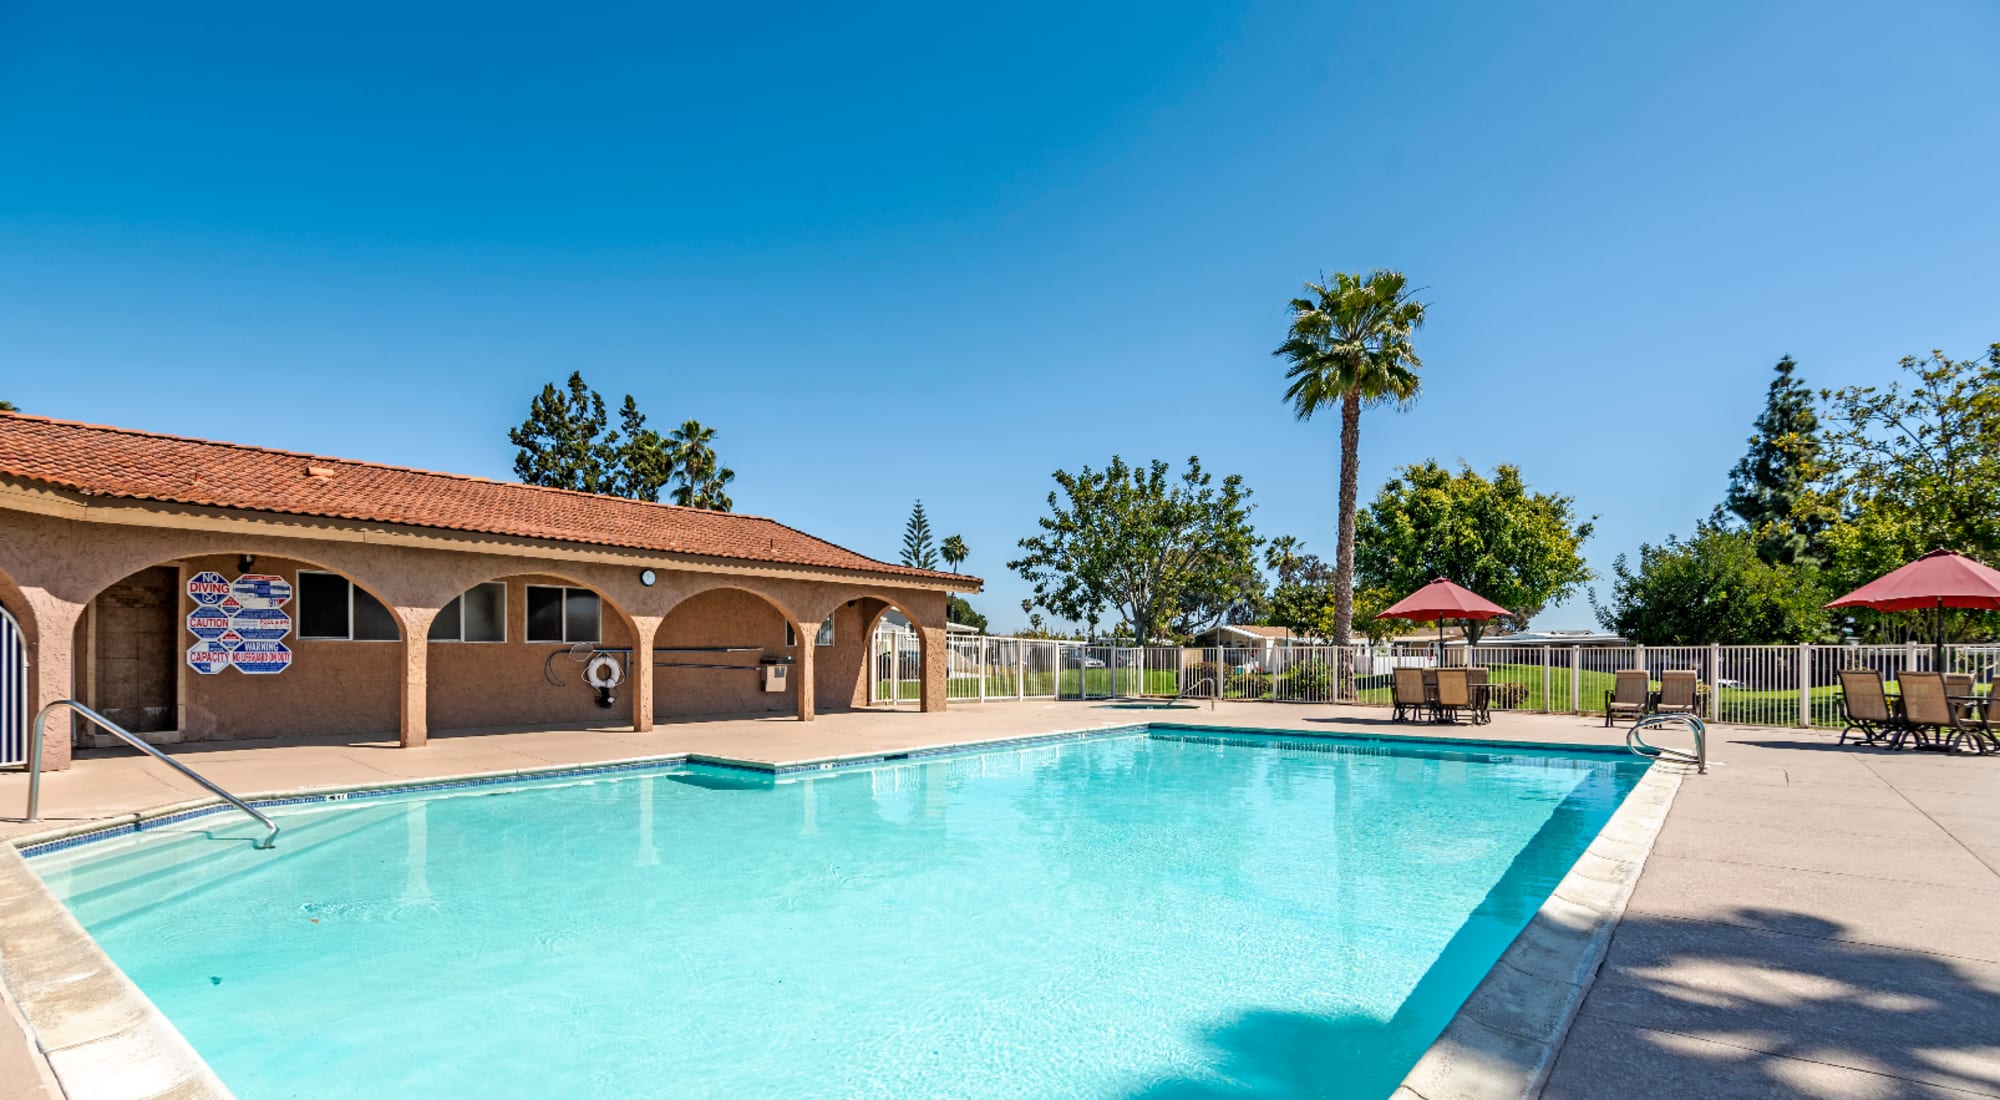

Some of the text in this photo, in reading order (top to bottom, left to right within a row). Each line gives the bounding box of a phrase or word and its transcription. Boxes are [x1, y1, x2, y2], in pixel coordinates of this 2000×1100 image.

[202, 573, 219, 583] NO
[190, 583, 230, 593] DIVING
[190, 618, 229, 628] CAUTION
[245, 641, 279, 651] WARNING
[190, 652, 230, 663] CAPACITY
[233, 652, 290, 663] NO LIFEGUARD ON DUTY
